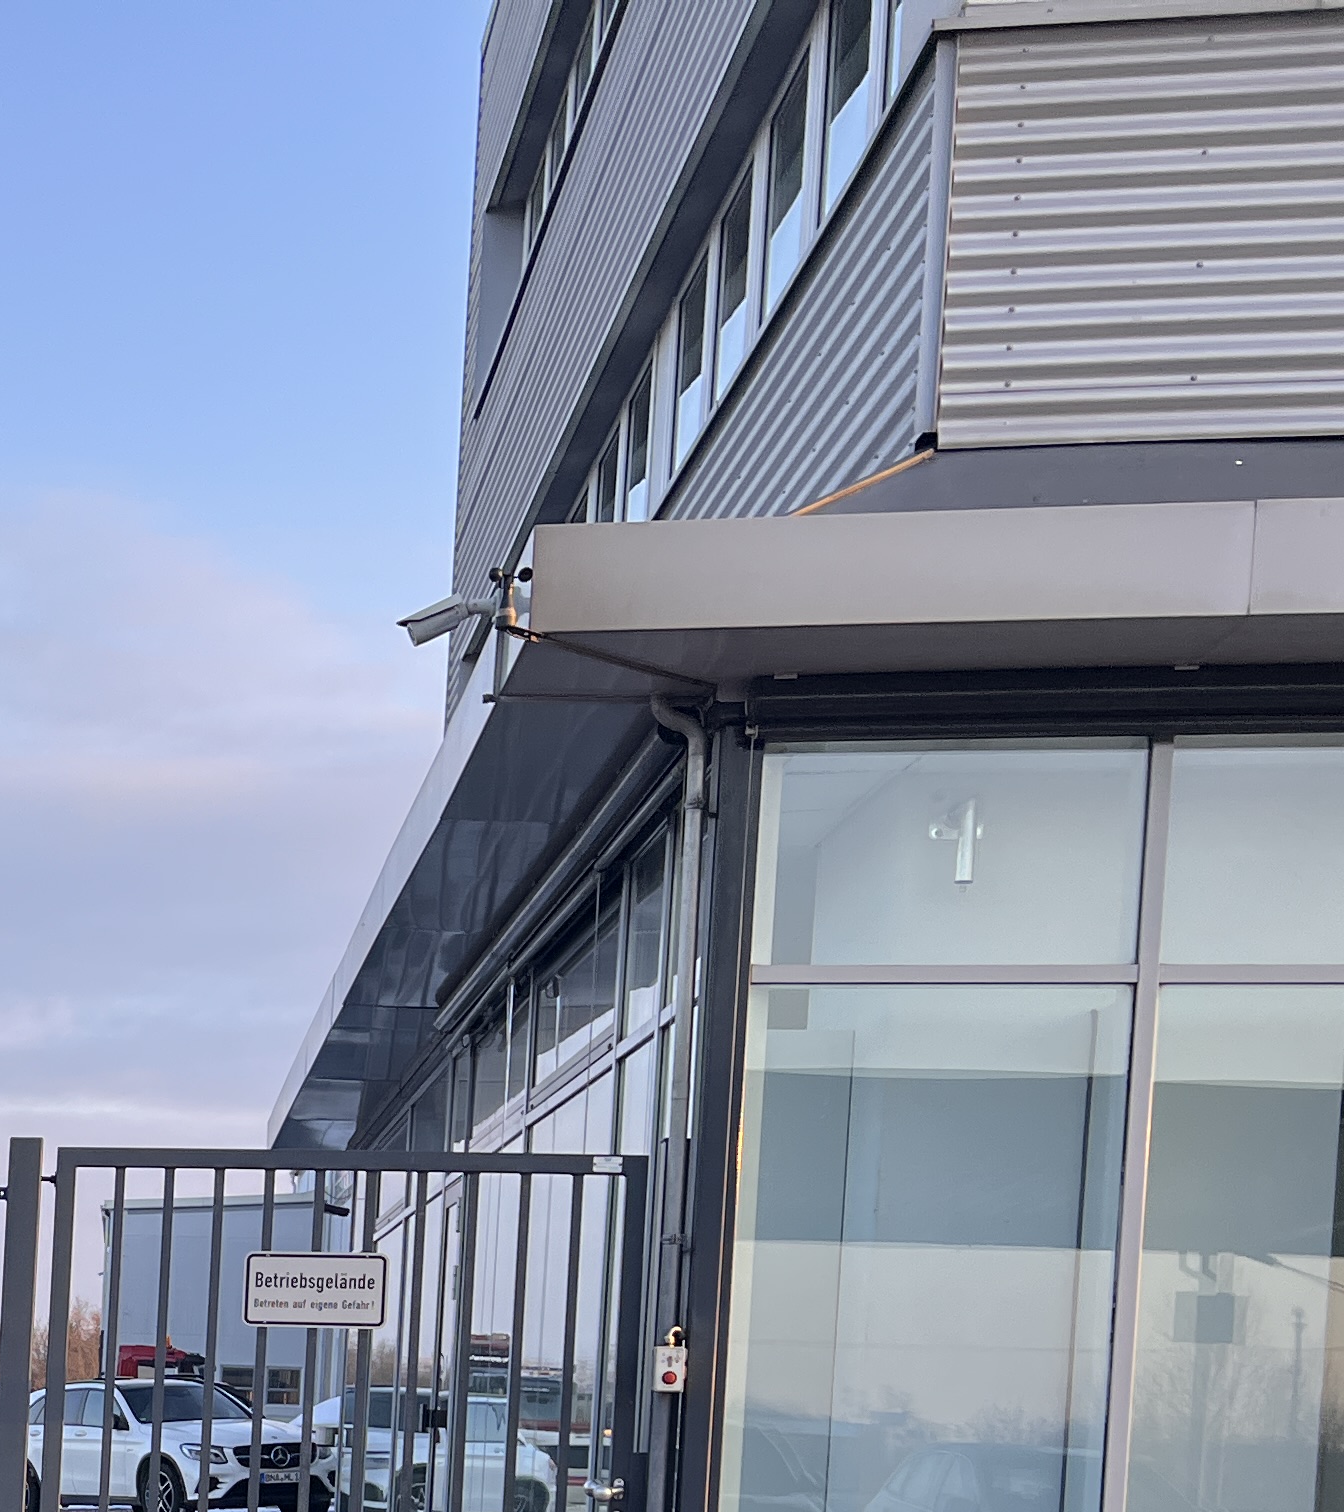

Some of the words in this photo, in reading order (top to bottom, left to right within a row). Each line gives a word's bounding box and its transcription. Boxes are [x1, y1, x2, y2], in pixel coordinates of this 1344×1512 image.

[254, 1271, 376, 1293] Betriebsgelände
[253, 1297, 289, 1309] Betreten
[292, 1298, 307, 1309] auf
[310, 1299, 339, 1311] eigene
